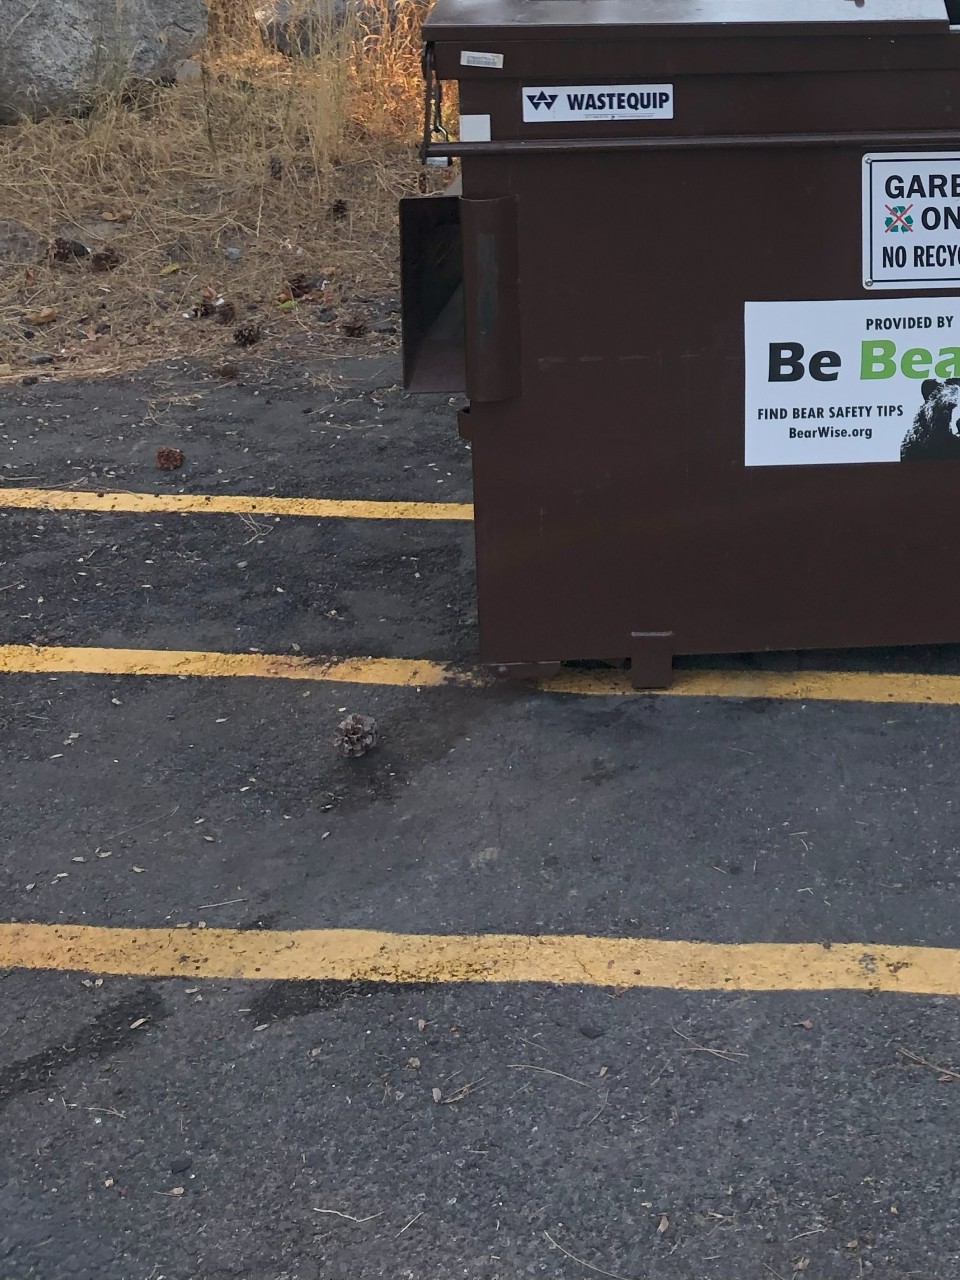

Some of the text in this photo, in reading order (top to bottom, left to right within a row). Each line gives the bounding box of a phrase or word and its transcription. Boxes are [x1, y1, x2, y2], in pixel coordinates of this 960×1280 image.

[567, 92, 670, 111] WASTEQUIP
[882, 245, 907, 268] NO
[866, 316, 954, 330] PROVIDED BY
[768, 341, 842, 382] Be
[757, 404, 904, 420] FIND BEAR SAFETY TIPS
[789, 426, 873, 439] BearWise.org
